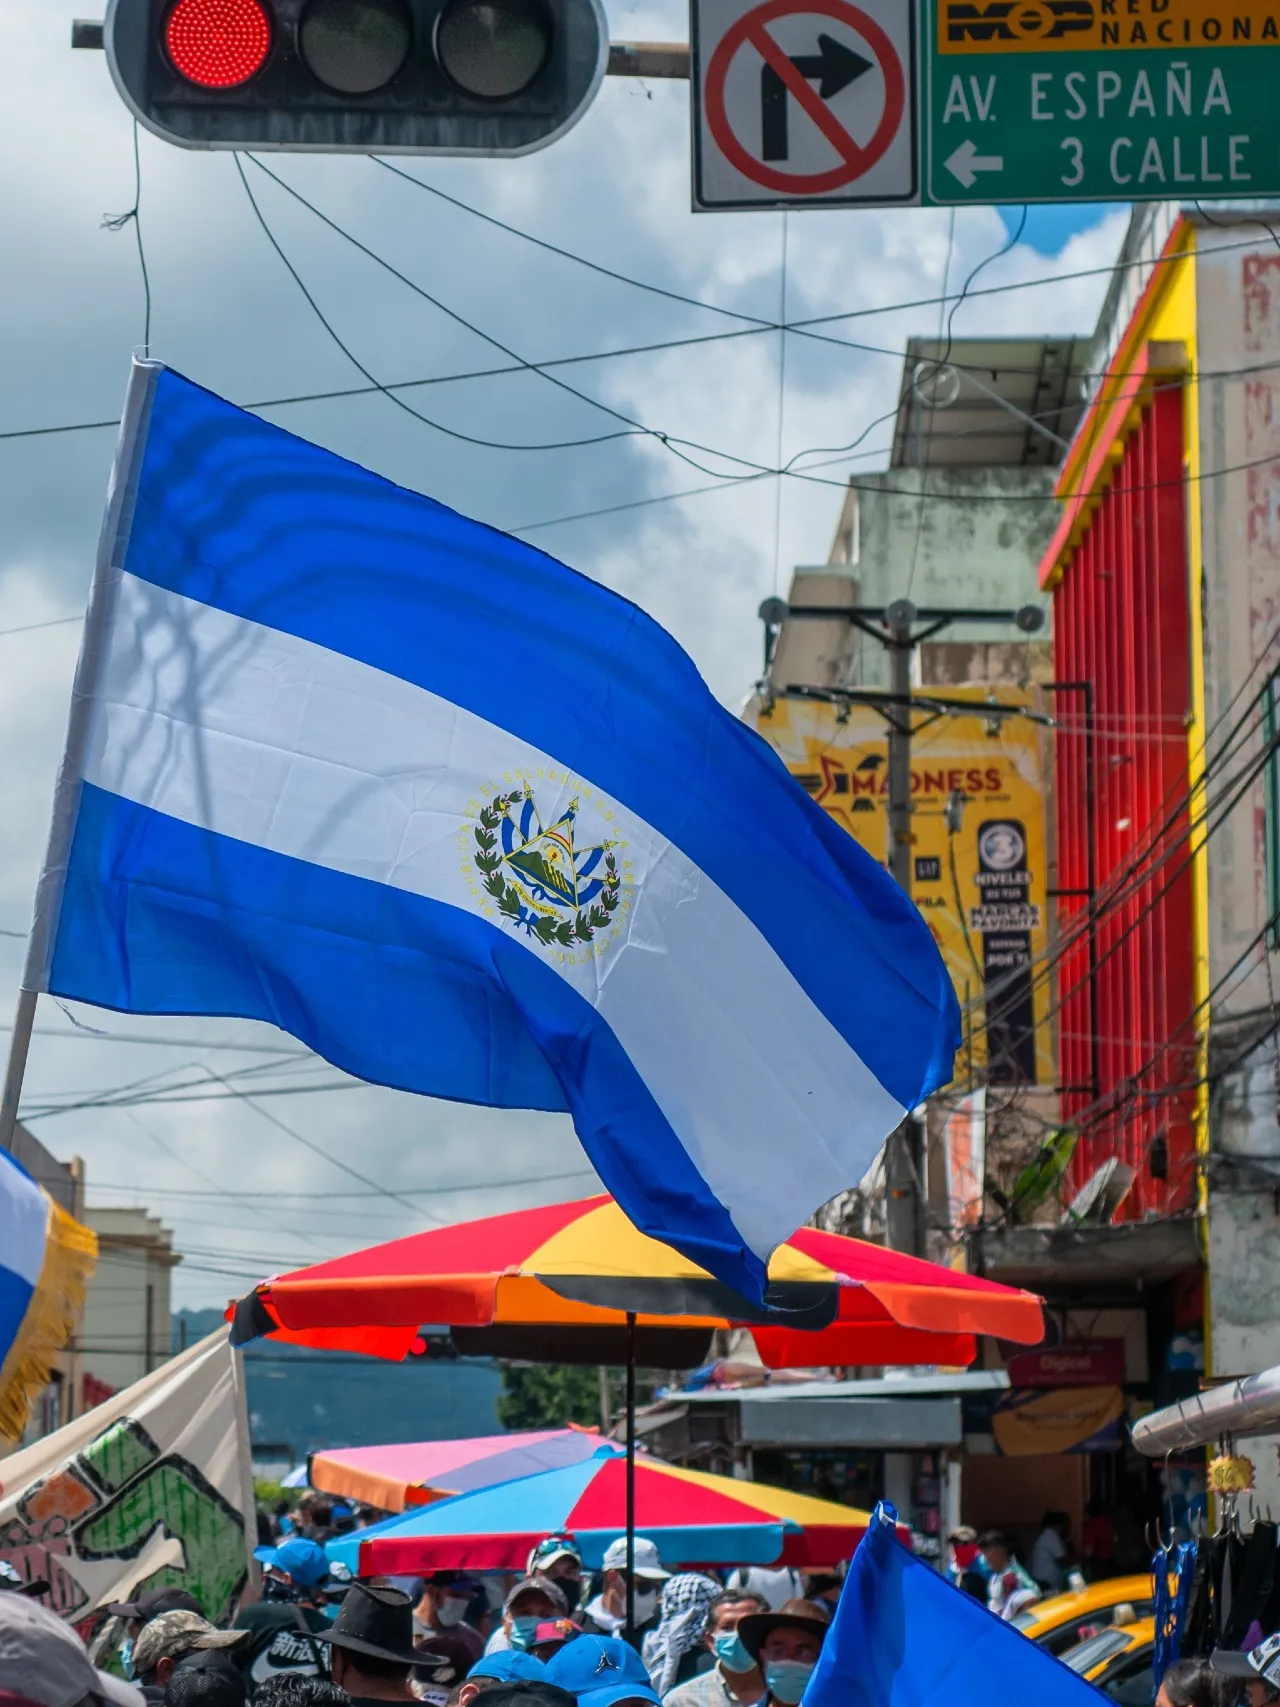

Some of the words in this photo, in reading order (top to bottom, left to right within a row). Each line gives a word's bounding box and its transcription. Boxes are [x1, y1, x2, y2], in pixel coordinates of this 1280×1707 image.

[947, 2, 1095, 42] MOP
[942, 75, 997, 123] AV.
[1031, 62, 1233, 121] ESPAÑA
[1060, 136, 1085, 186] 3
[1110, 135, 1252, 184] CALLE
